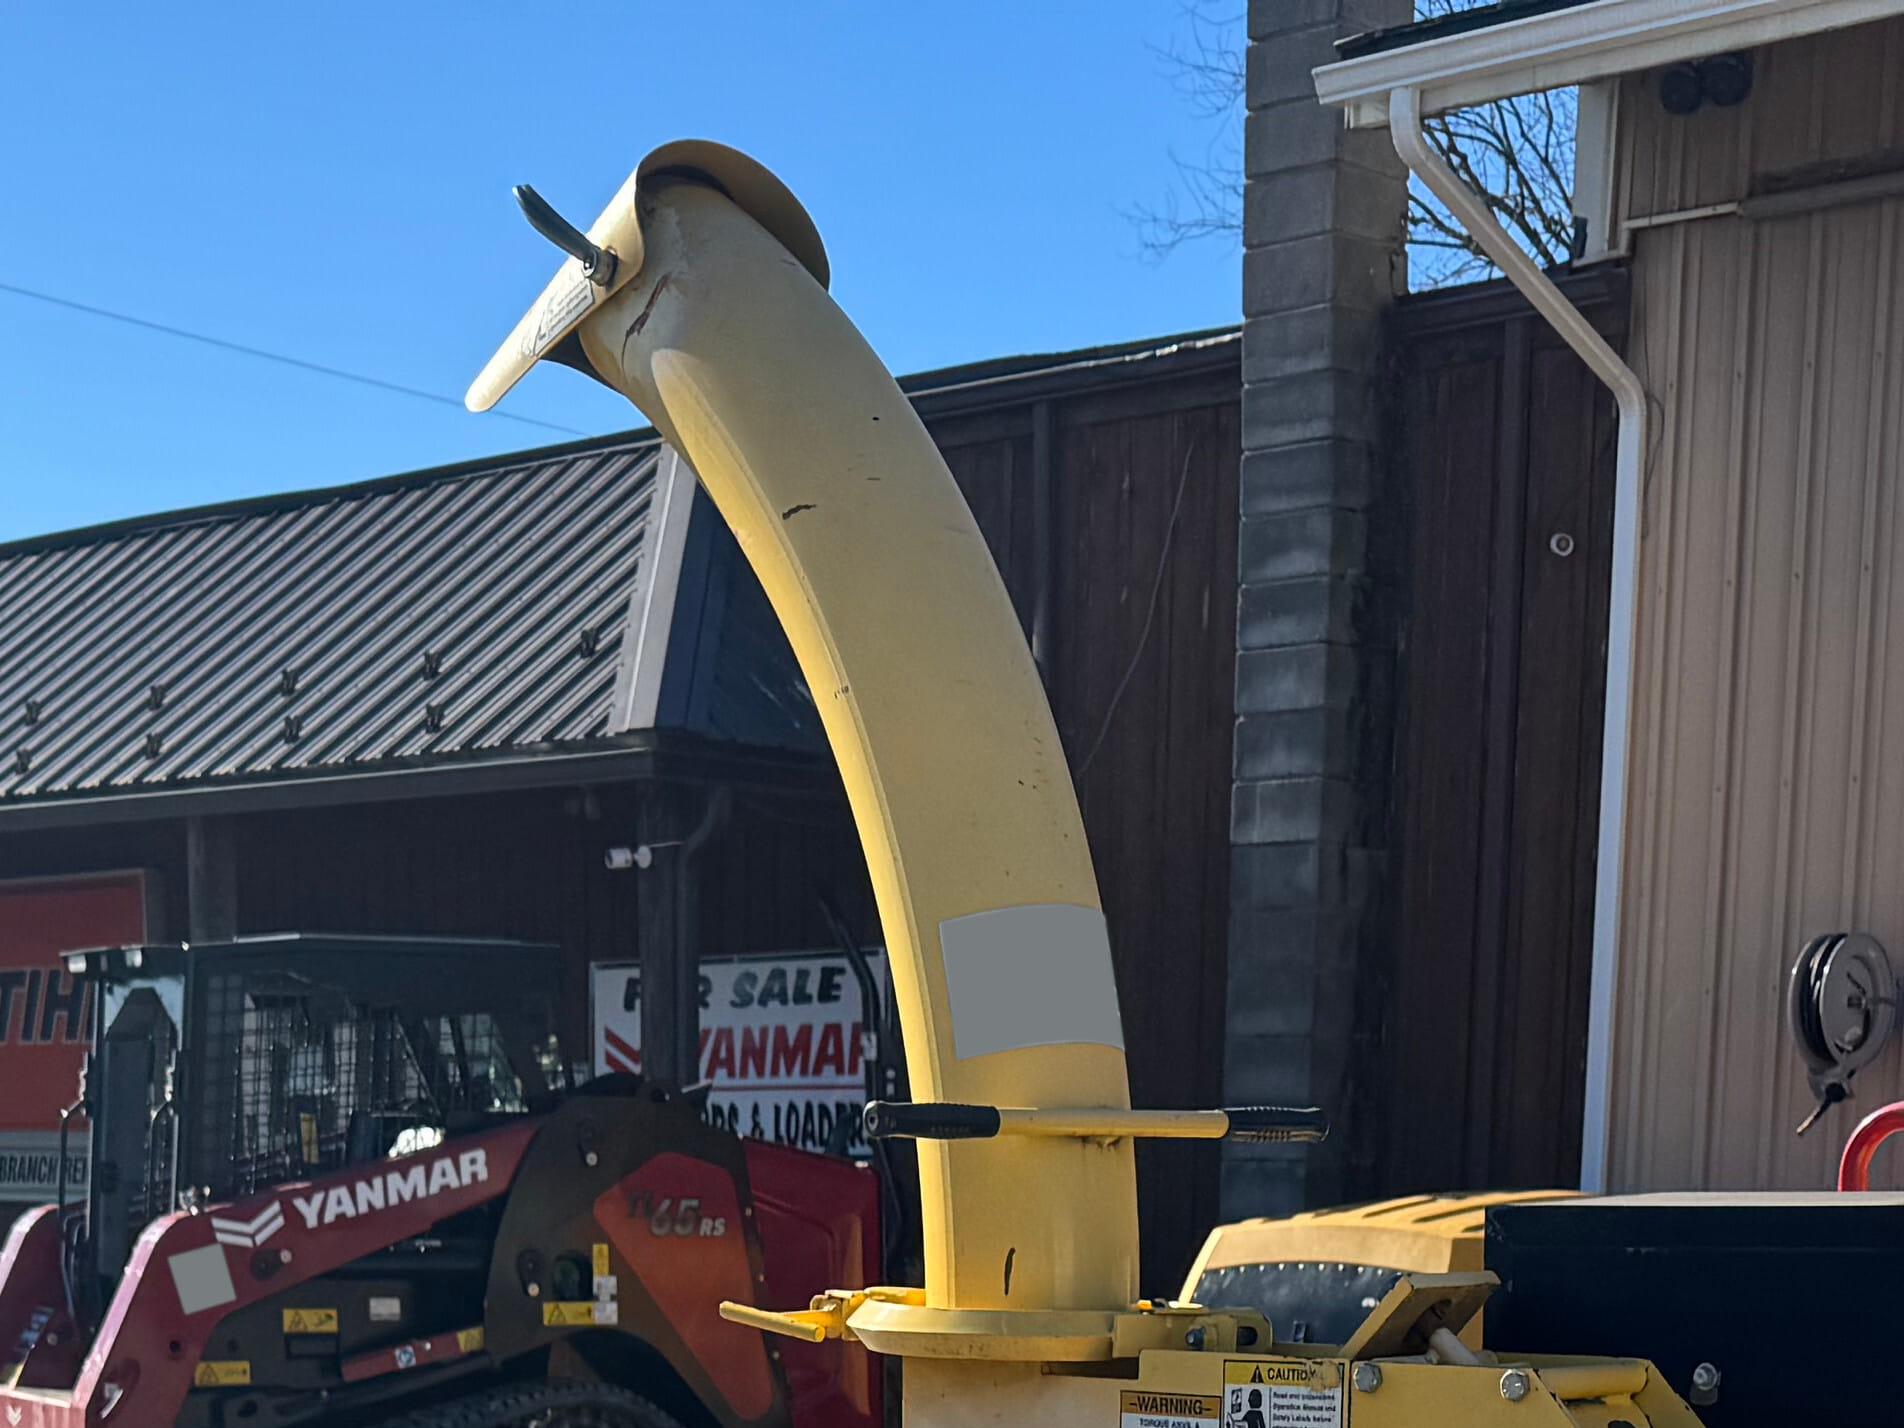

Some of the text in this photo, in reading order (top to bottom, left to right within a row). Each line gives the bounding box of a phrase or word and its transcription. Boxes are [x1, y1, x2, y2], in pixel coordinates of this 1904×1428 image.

[623, 965, 846, 1012] FR SALE
[774, 1099, 870, 1149] LOADR
[292, 1148, 489, 1230] YANMAR
